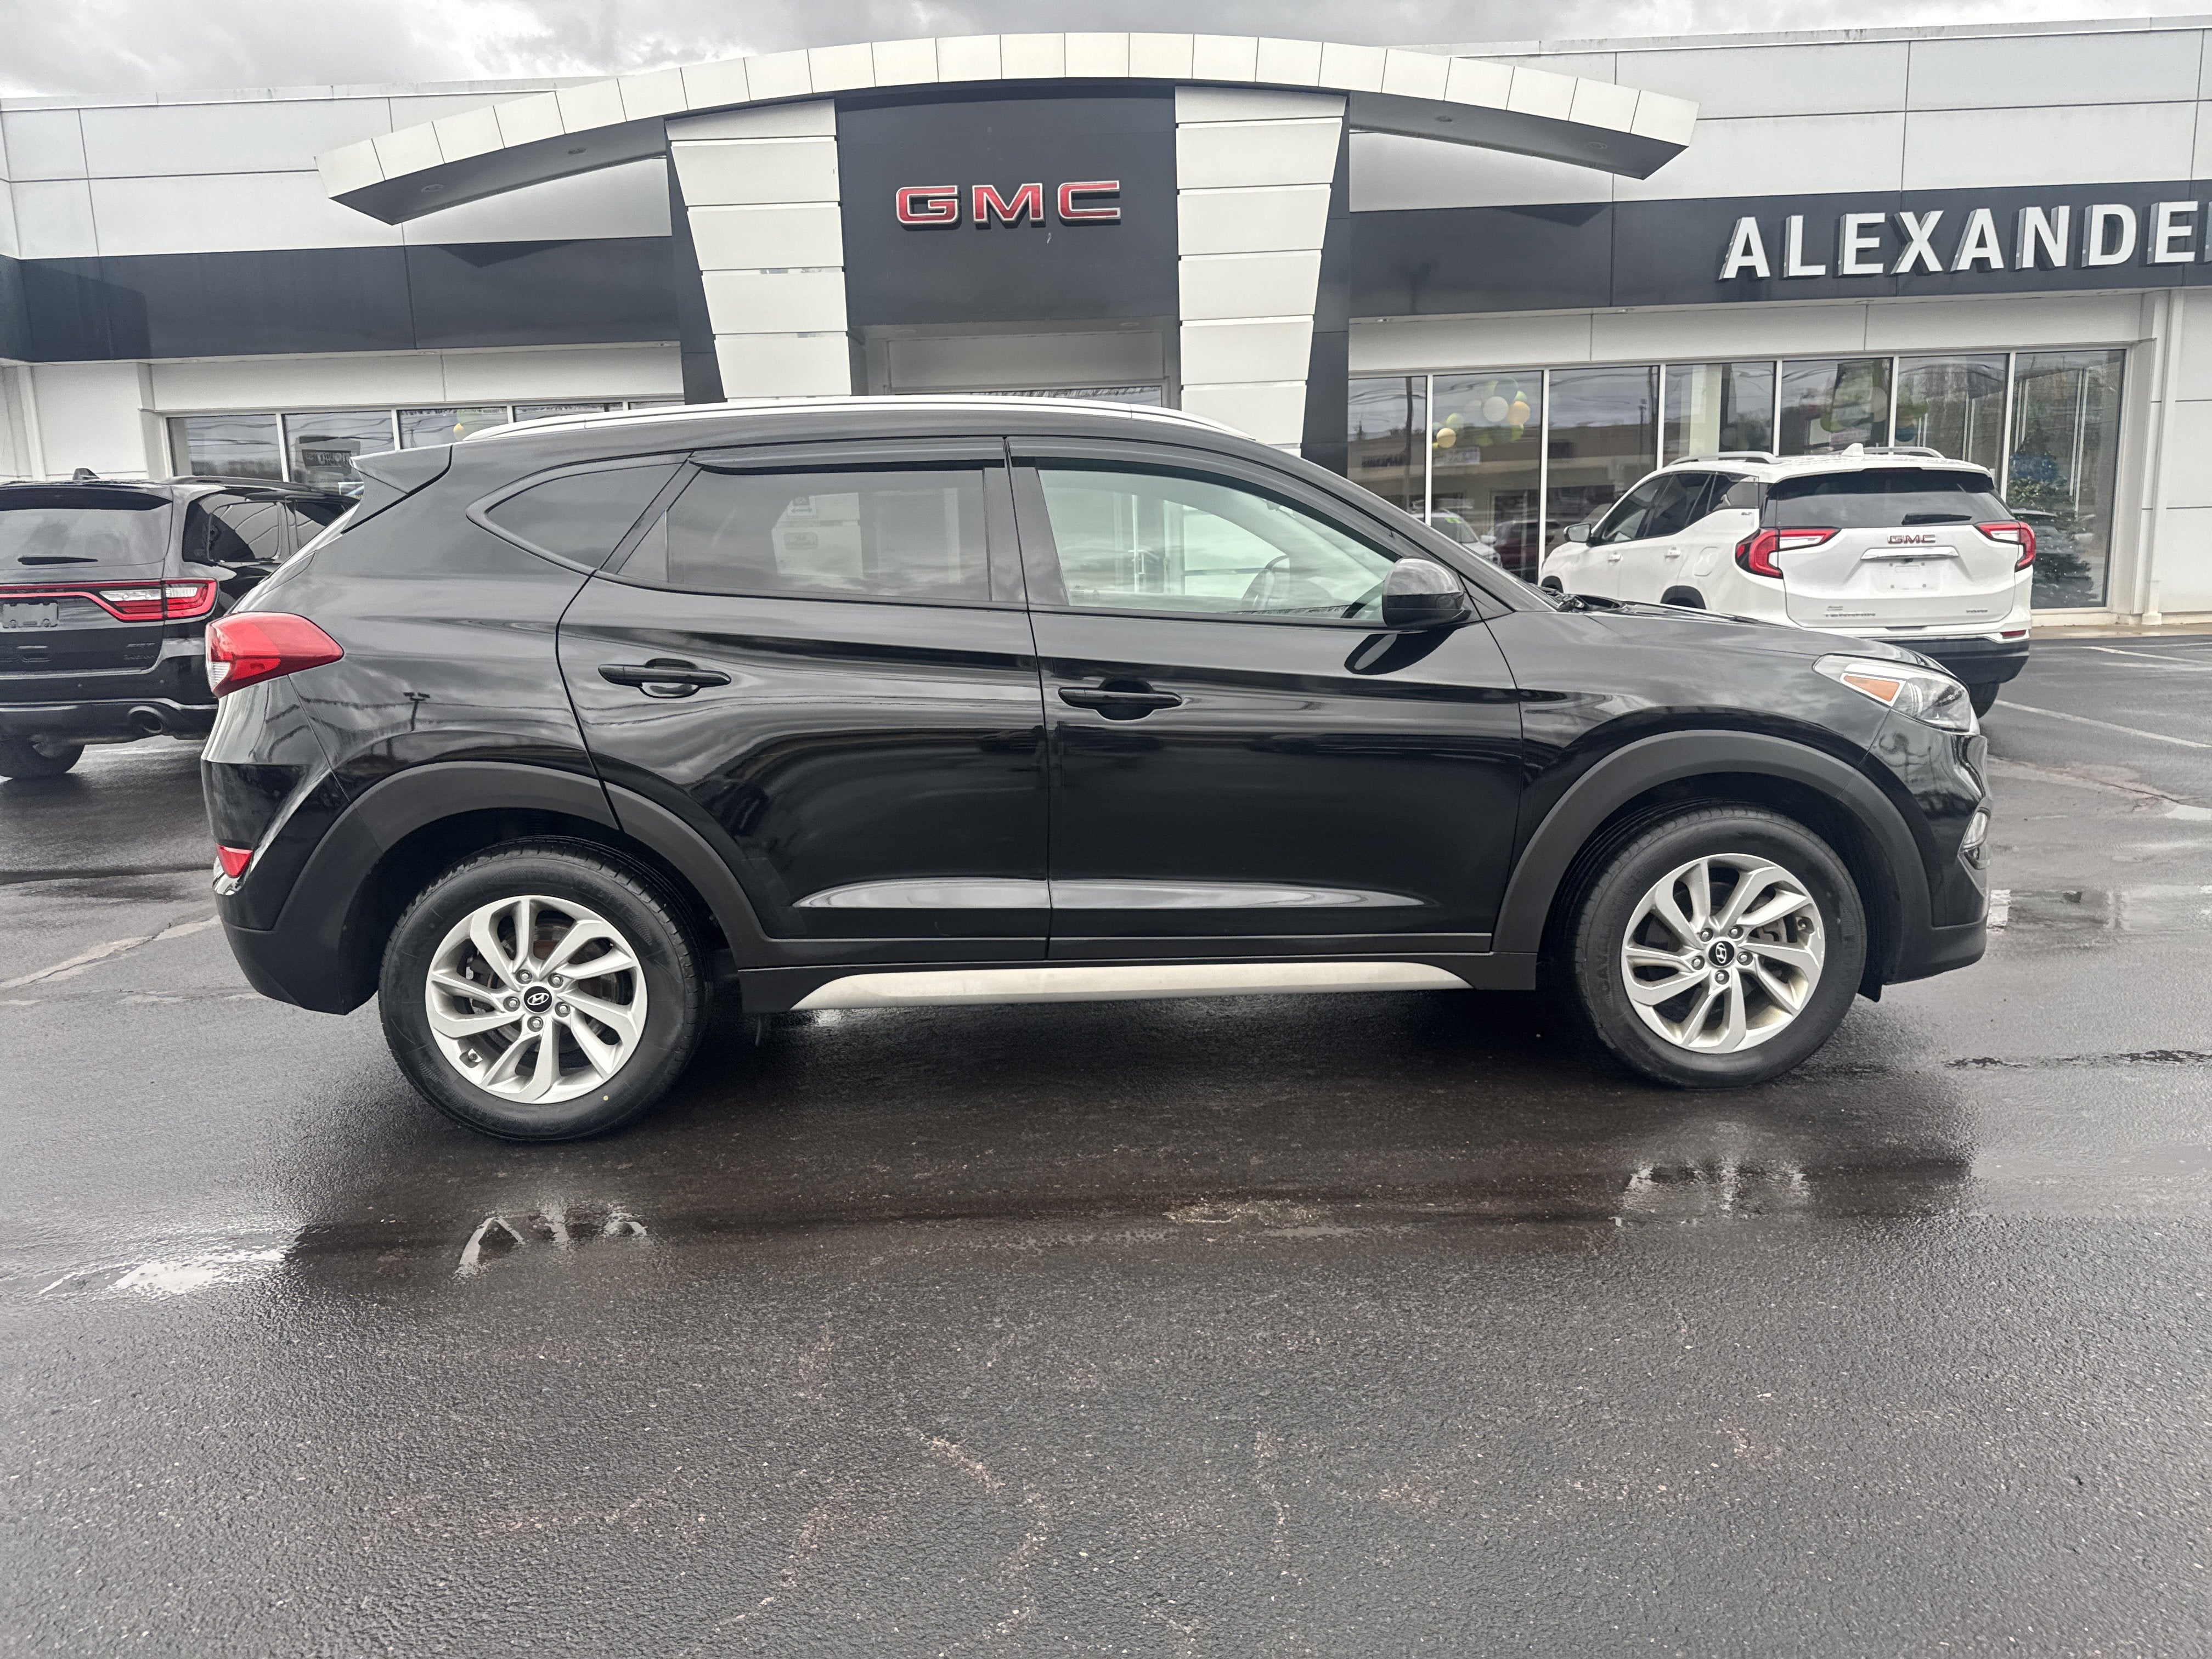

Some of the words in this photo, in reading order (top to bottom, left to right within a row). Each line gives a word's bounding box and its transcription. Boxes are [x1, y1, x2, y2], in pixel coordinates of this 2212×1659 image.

[895, 179, 1121, 225] GMC
[1719, 201, 2212, 280] ALEXANDE
[1887, 534, 1936, 544] GMC
